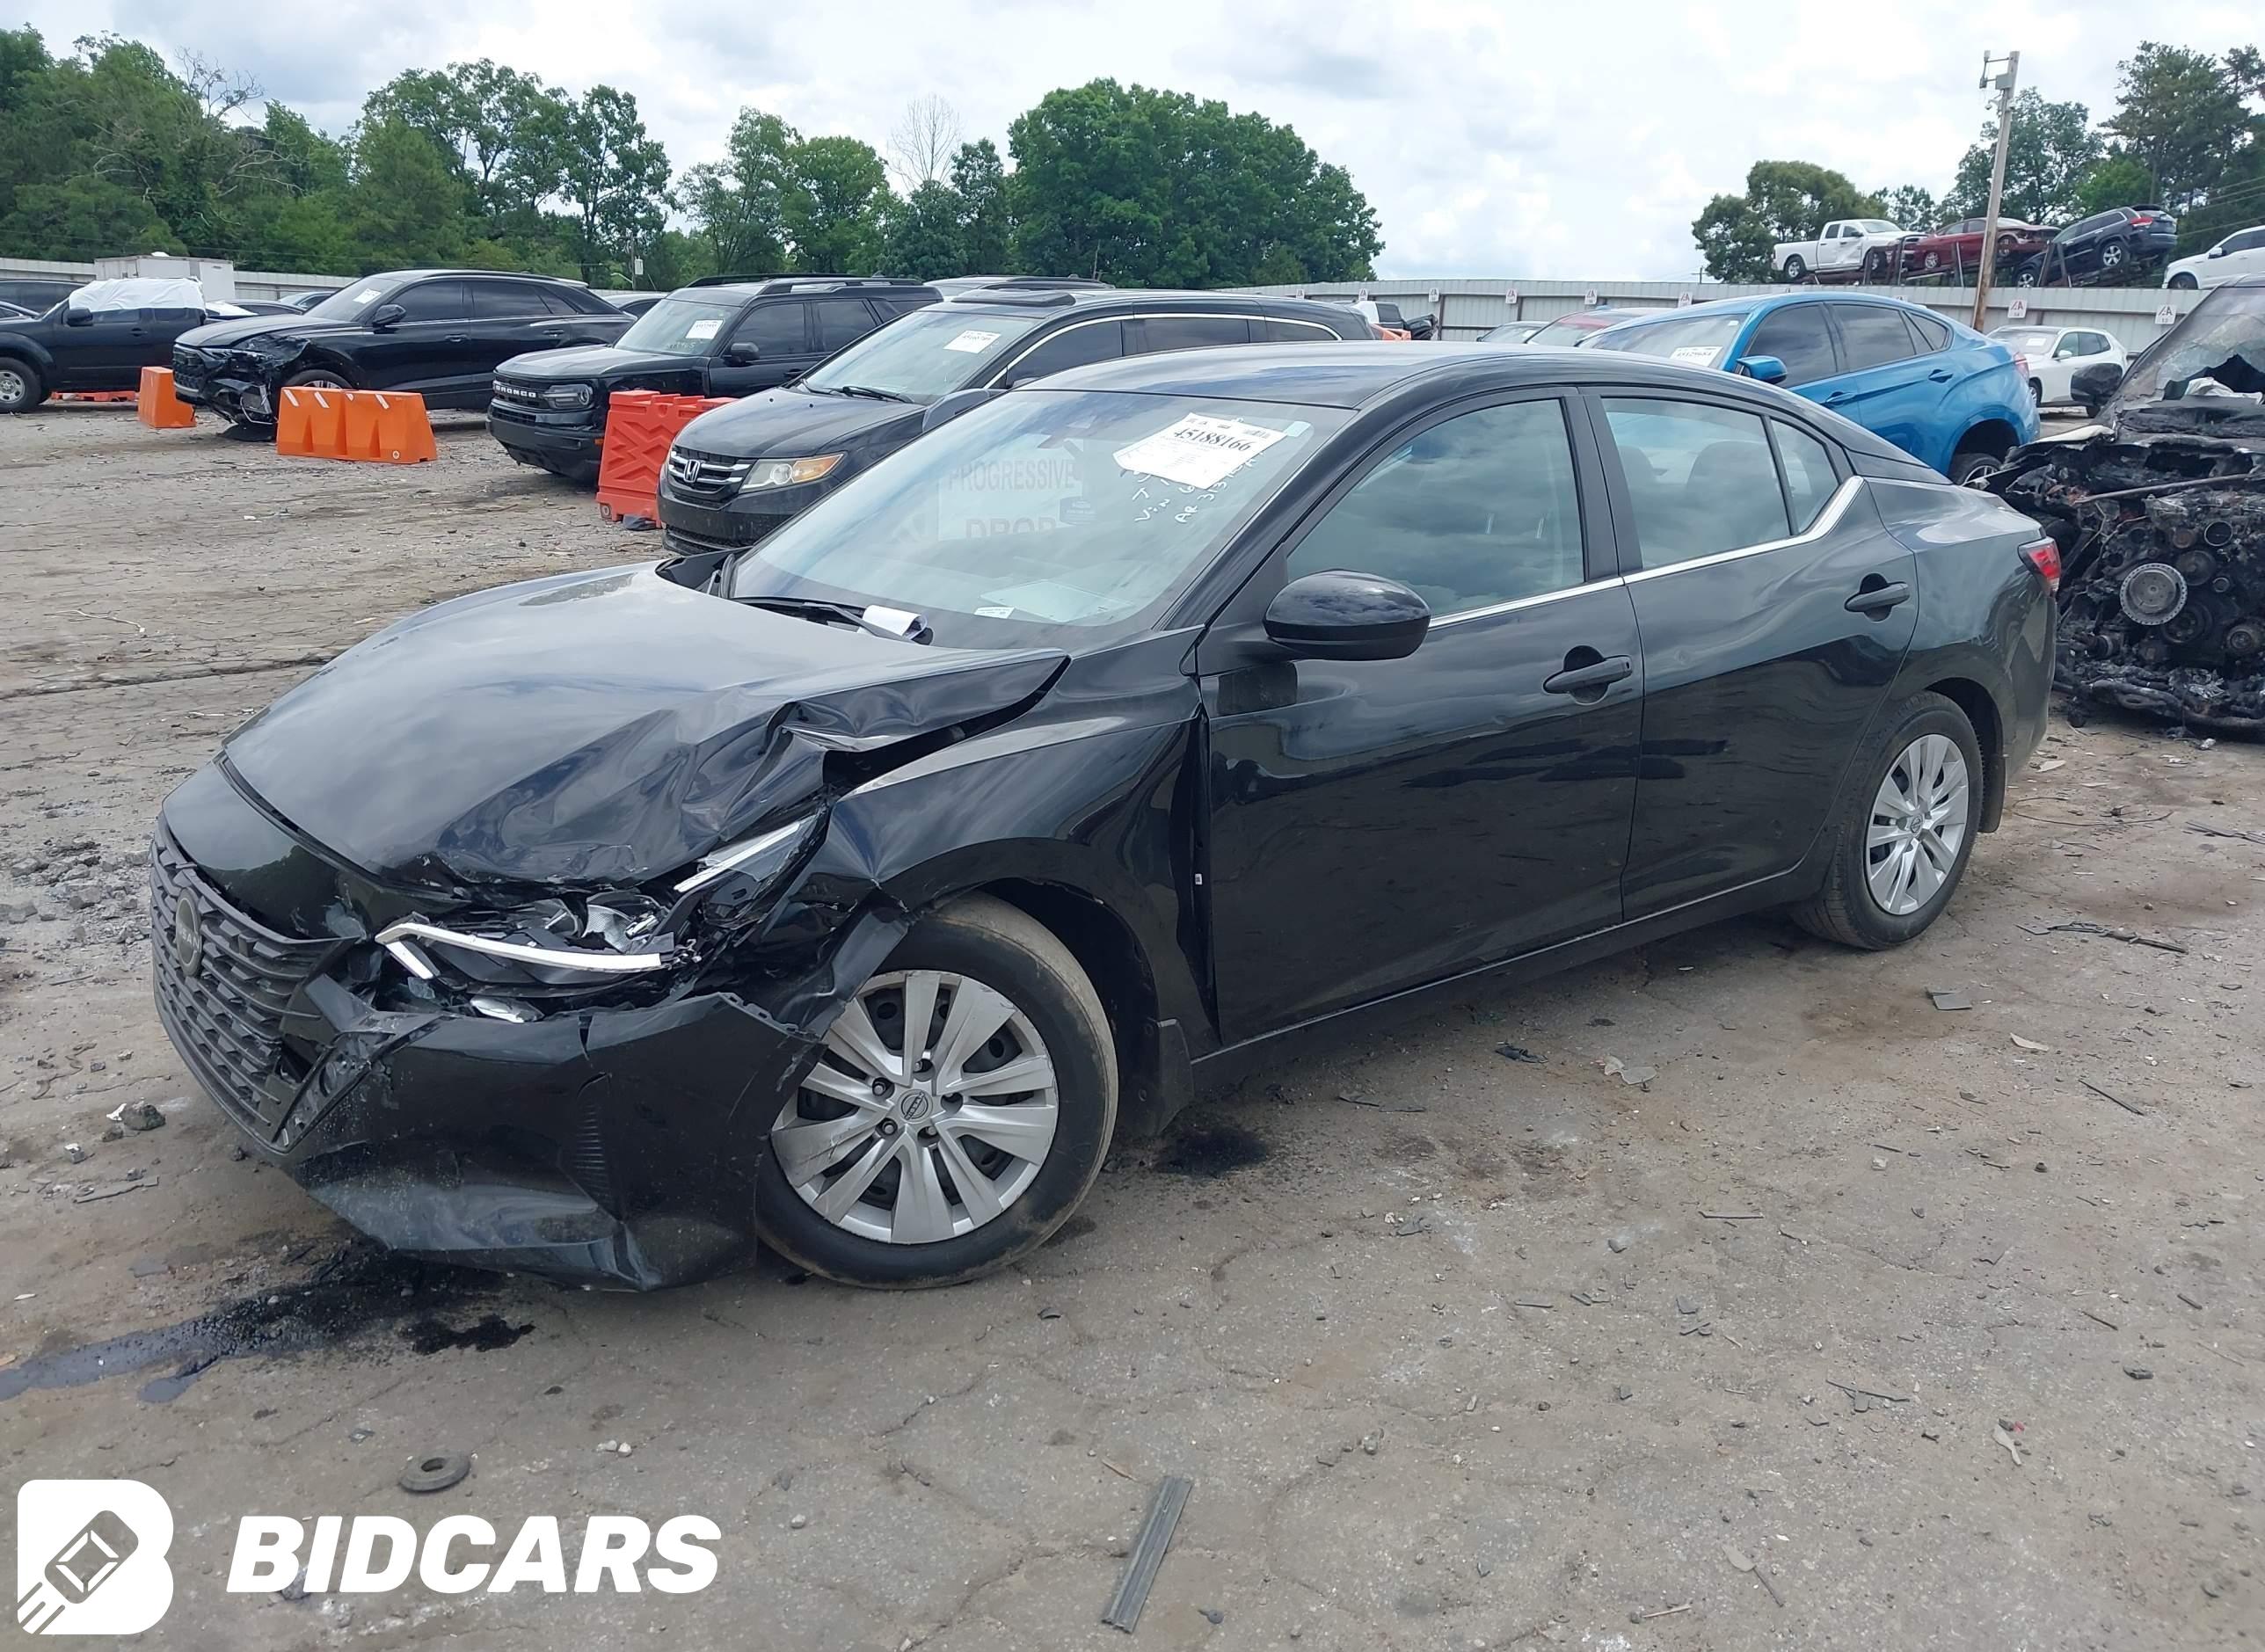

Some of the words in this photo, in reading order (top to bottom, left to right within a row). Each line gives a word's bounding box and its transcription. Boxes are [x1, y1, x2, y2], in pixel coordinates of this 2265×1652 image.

[495, 385, 536, 397] BRONCO
[1174, 427, 1256, 452] 45188166
[949, 458, 1075, 491] PROGRESSIVE
